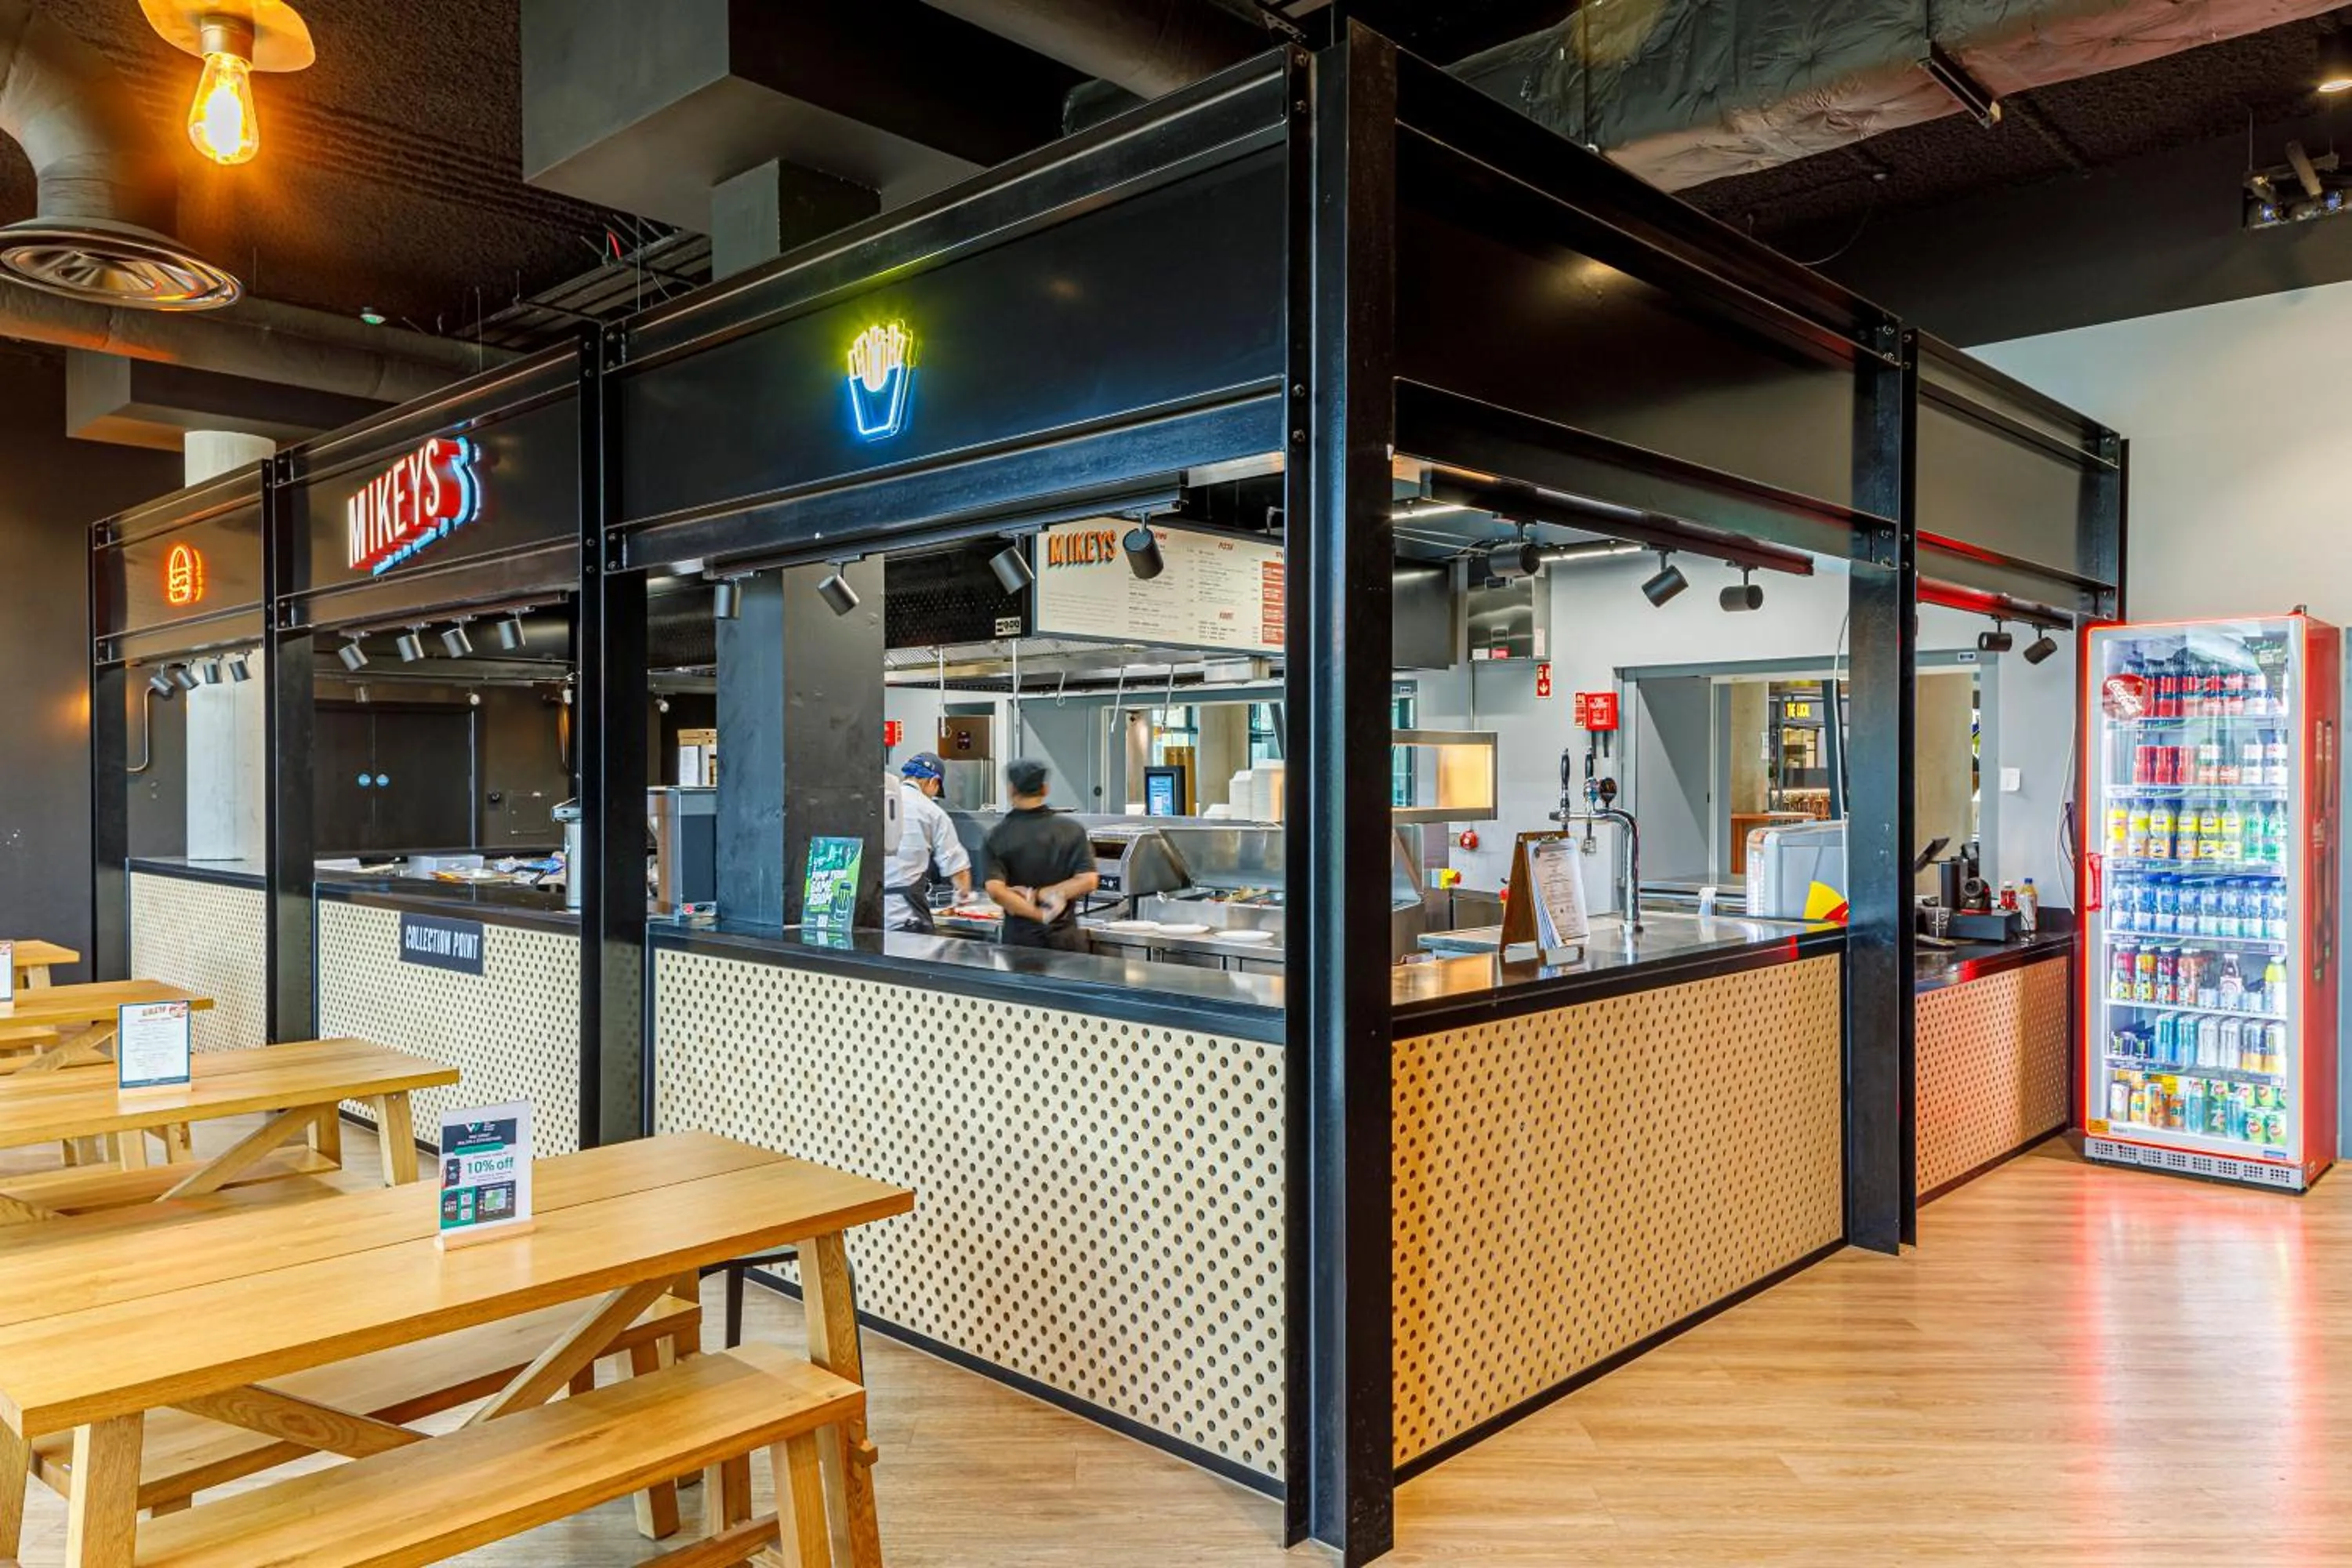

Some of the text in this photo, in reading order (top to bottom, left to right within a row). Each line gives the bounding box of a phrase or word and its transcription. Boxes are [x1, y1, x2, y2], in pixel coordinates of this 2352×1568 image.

[348, 438, 441, 568] MIKEYS
[1048, 530, 1116, 564] MIKEYS
[405, 924, 479, 960] COLLECTION POINT
[467, 1156, 514, 1174] 10% off
